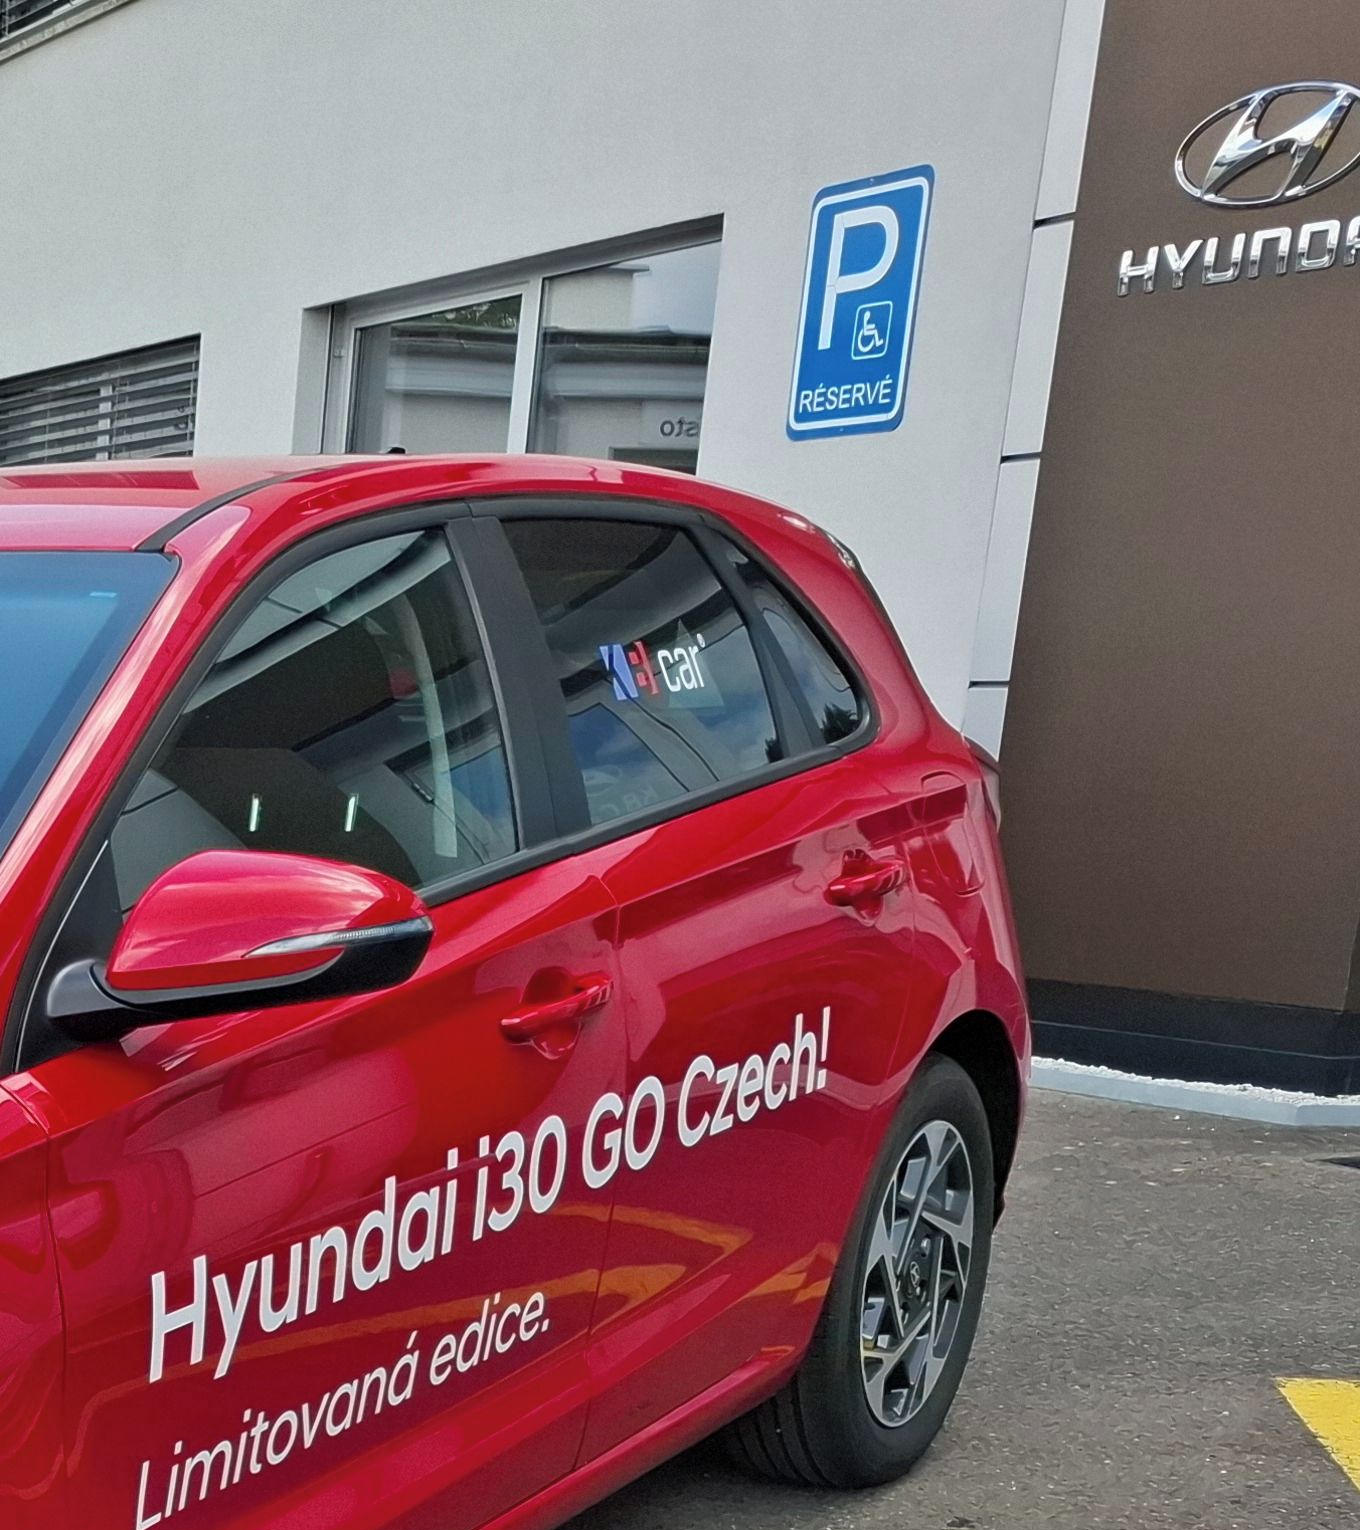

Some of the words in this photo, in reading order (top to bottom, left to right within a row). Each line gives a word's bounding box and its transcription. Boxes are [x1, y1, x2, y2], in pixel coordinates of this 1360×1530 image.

[818, 205, 899, 350] P
[799, 374, 893, 414] RÉSERVÉ
[147, 1147, 460, 1383] Hyundai
[473, 1113, 568, 1242] i30
[581, 1074, 666, 1191] GO
[677, 1005, 833, 1148] Czech!
[428, 1290, 551, 1388] edice.
